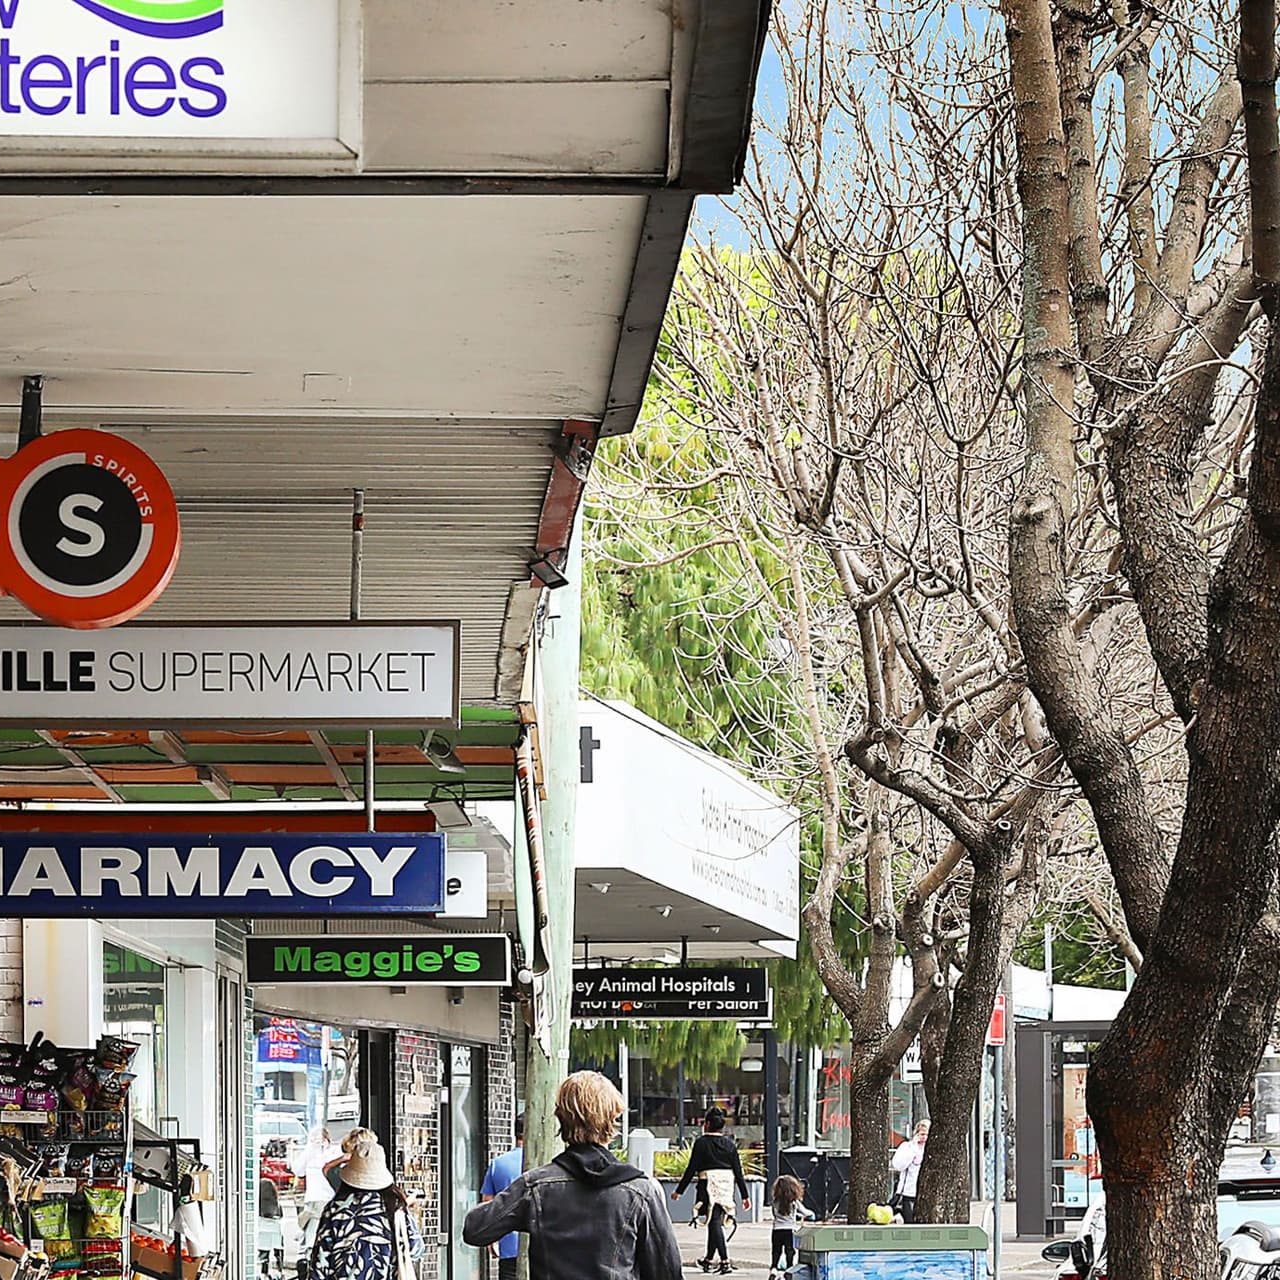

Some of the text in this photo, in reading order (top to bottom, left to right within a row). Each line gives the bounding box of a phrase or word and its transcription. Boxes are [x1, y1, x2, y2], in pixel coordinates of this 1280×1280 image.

[91, 454, 153, 518] SPIRITS
[108, 650, 436, 693] SUPERMARKET
[273, 945, 481, 978] Maggie's
[599, 976, 656, 992] Animal
[661, 976, 736, 996] Hospitals
